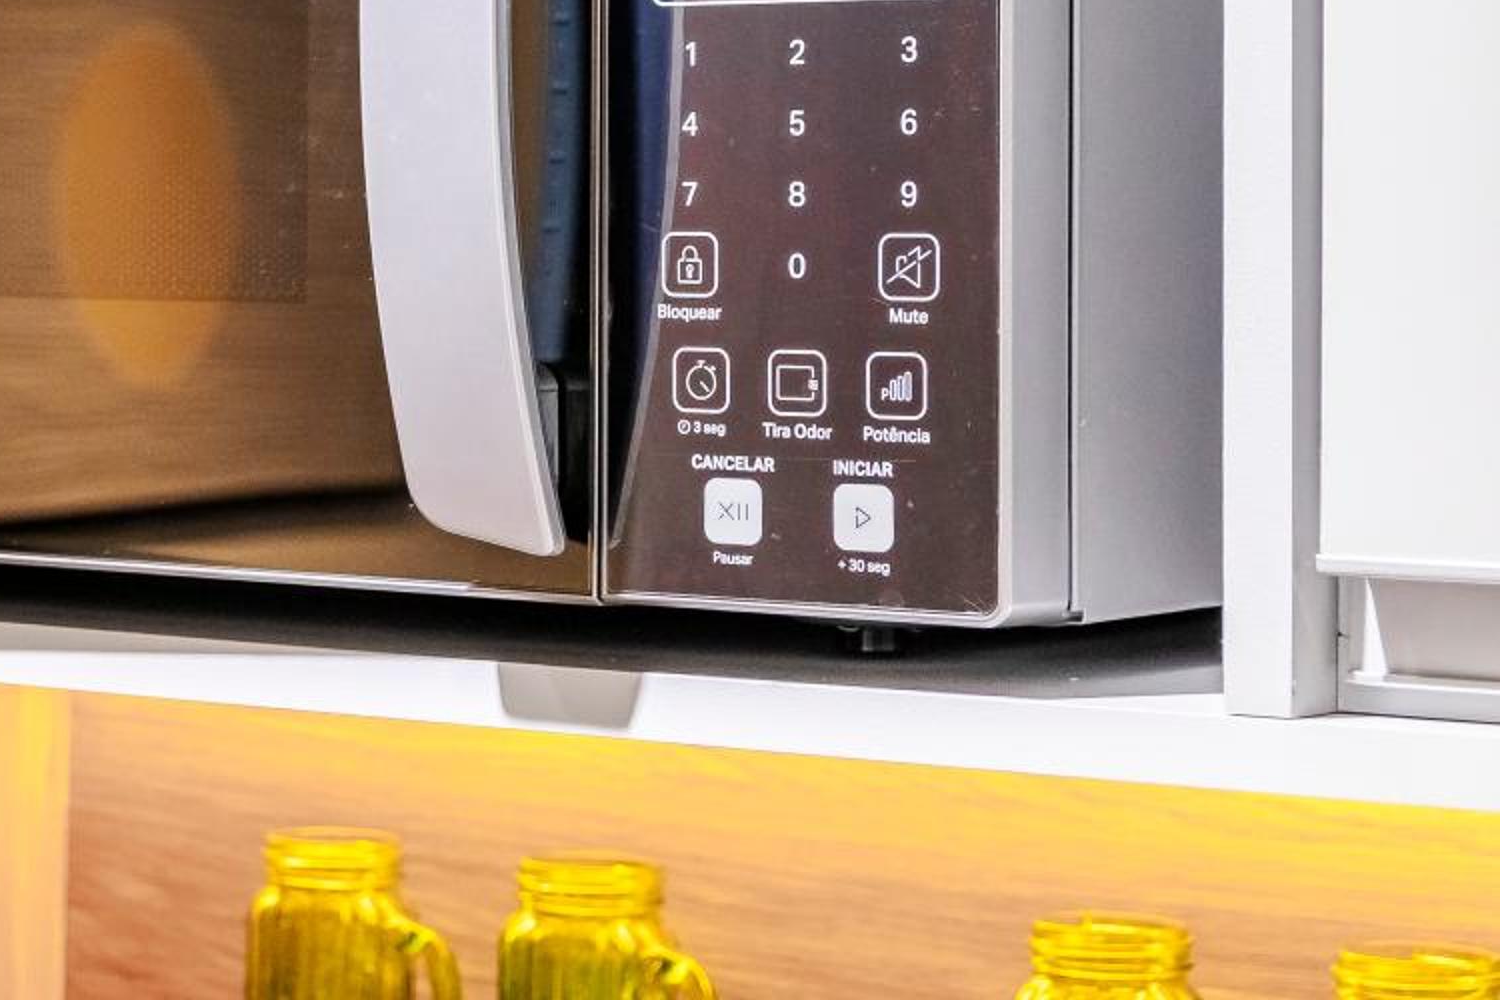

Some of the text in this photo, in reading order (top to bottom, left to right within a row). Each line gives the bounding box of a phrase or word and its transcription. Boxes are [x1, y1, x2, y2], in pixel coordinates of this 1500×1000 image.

[685, 42, 696, 67] 1
[789, 40, 805, 65] 2
[901, 36, 918, 62] 3
[681, 111, 698, 136] 4
[789, 110, 805, 136] 5
[900, 108, 917, 135] 6
[682, 182, 698, 206] 7
[788, 181, 806, 206] 8
[901, 181, 917, 207] 9
[788, 253, 806, 279] 0
[657, 304, 722, 321] Bloquear
[889, 307, 929, 325] Mute
[693, 422, 726, 437] 3 seg
[762, 422, 832, 440] Tira Odor
[863, 426, 931, 444] Potência
[691, 454, 775, 473] CANCELAR
[833, 460, 894, 478] INICIAR
[713, 551, 753, 566] Pausar
[848, 558, 865, 573] 30
[867, 561, 890, 577] seg
